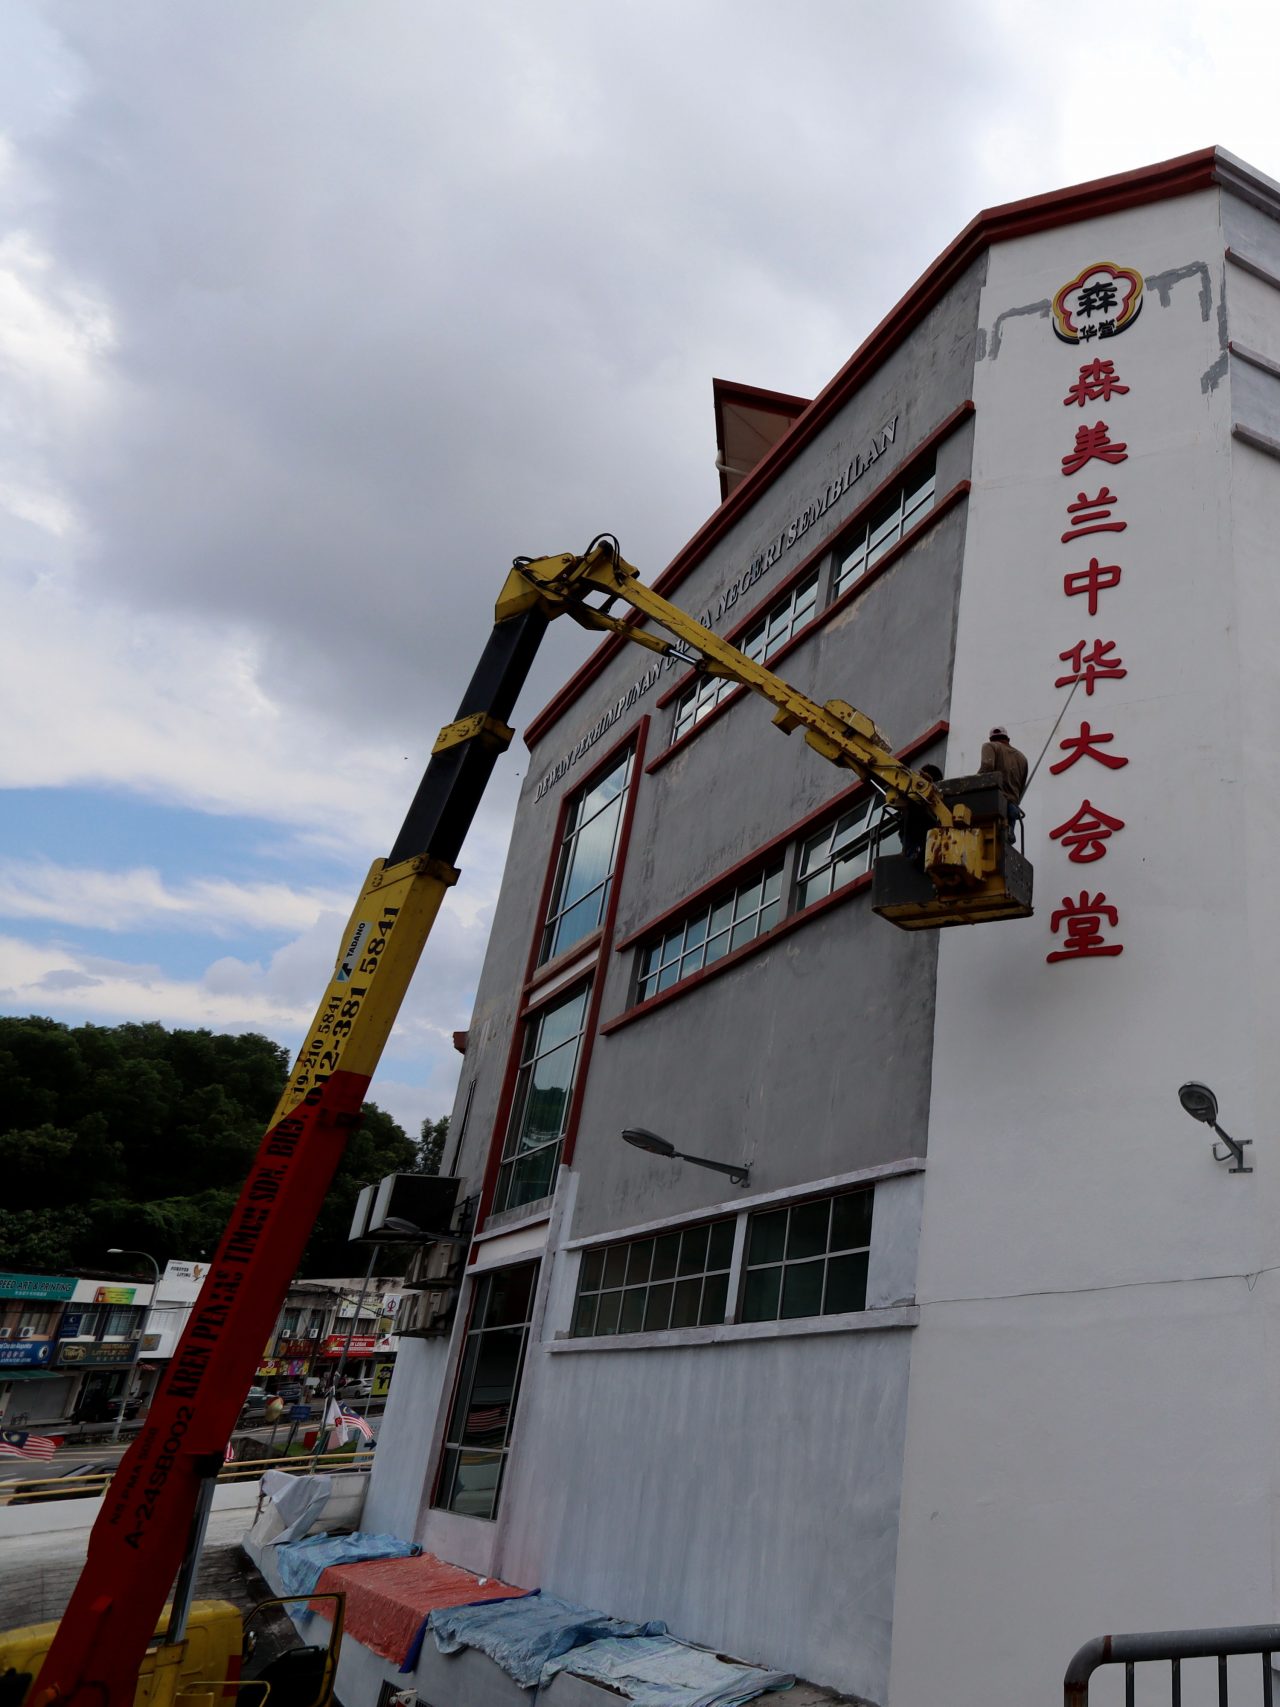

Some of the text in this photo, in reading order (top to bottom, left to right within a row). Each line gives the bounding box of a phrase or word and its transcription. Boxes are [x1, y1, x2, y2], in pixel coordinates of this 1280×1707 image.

[1077, 281, 1118, 318] 森
[534, 415, 899, 803] DEWAN PERHIMPUNAN NEGERI SEMBILAN
[1046, 358, 1130, 963] 森美兰中华大会堂
[346, 922, 366, 959] TADANO
[305, 907, 401, 1107] 012-381 5841
[290, 996, 343, 1104] 19-210 5841
[17, 1280, 32, 1290] ART
[39, 1282, 72, 1292] PRINTING
[166, 1341, 207, 1400] KREN
